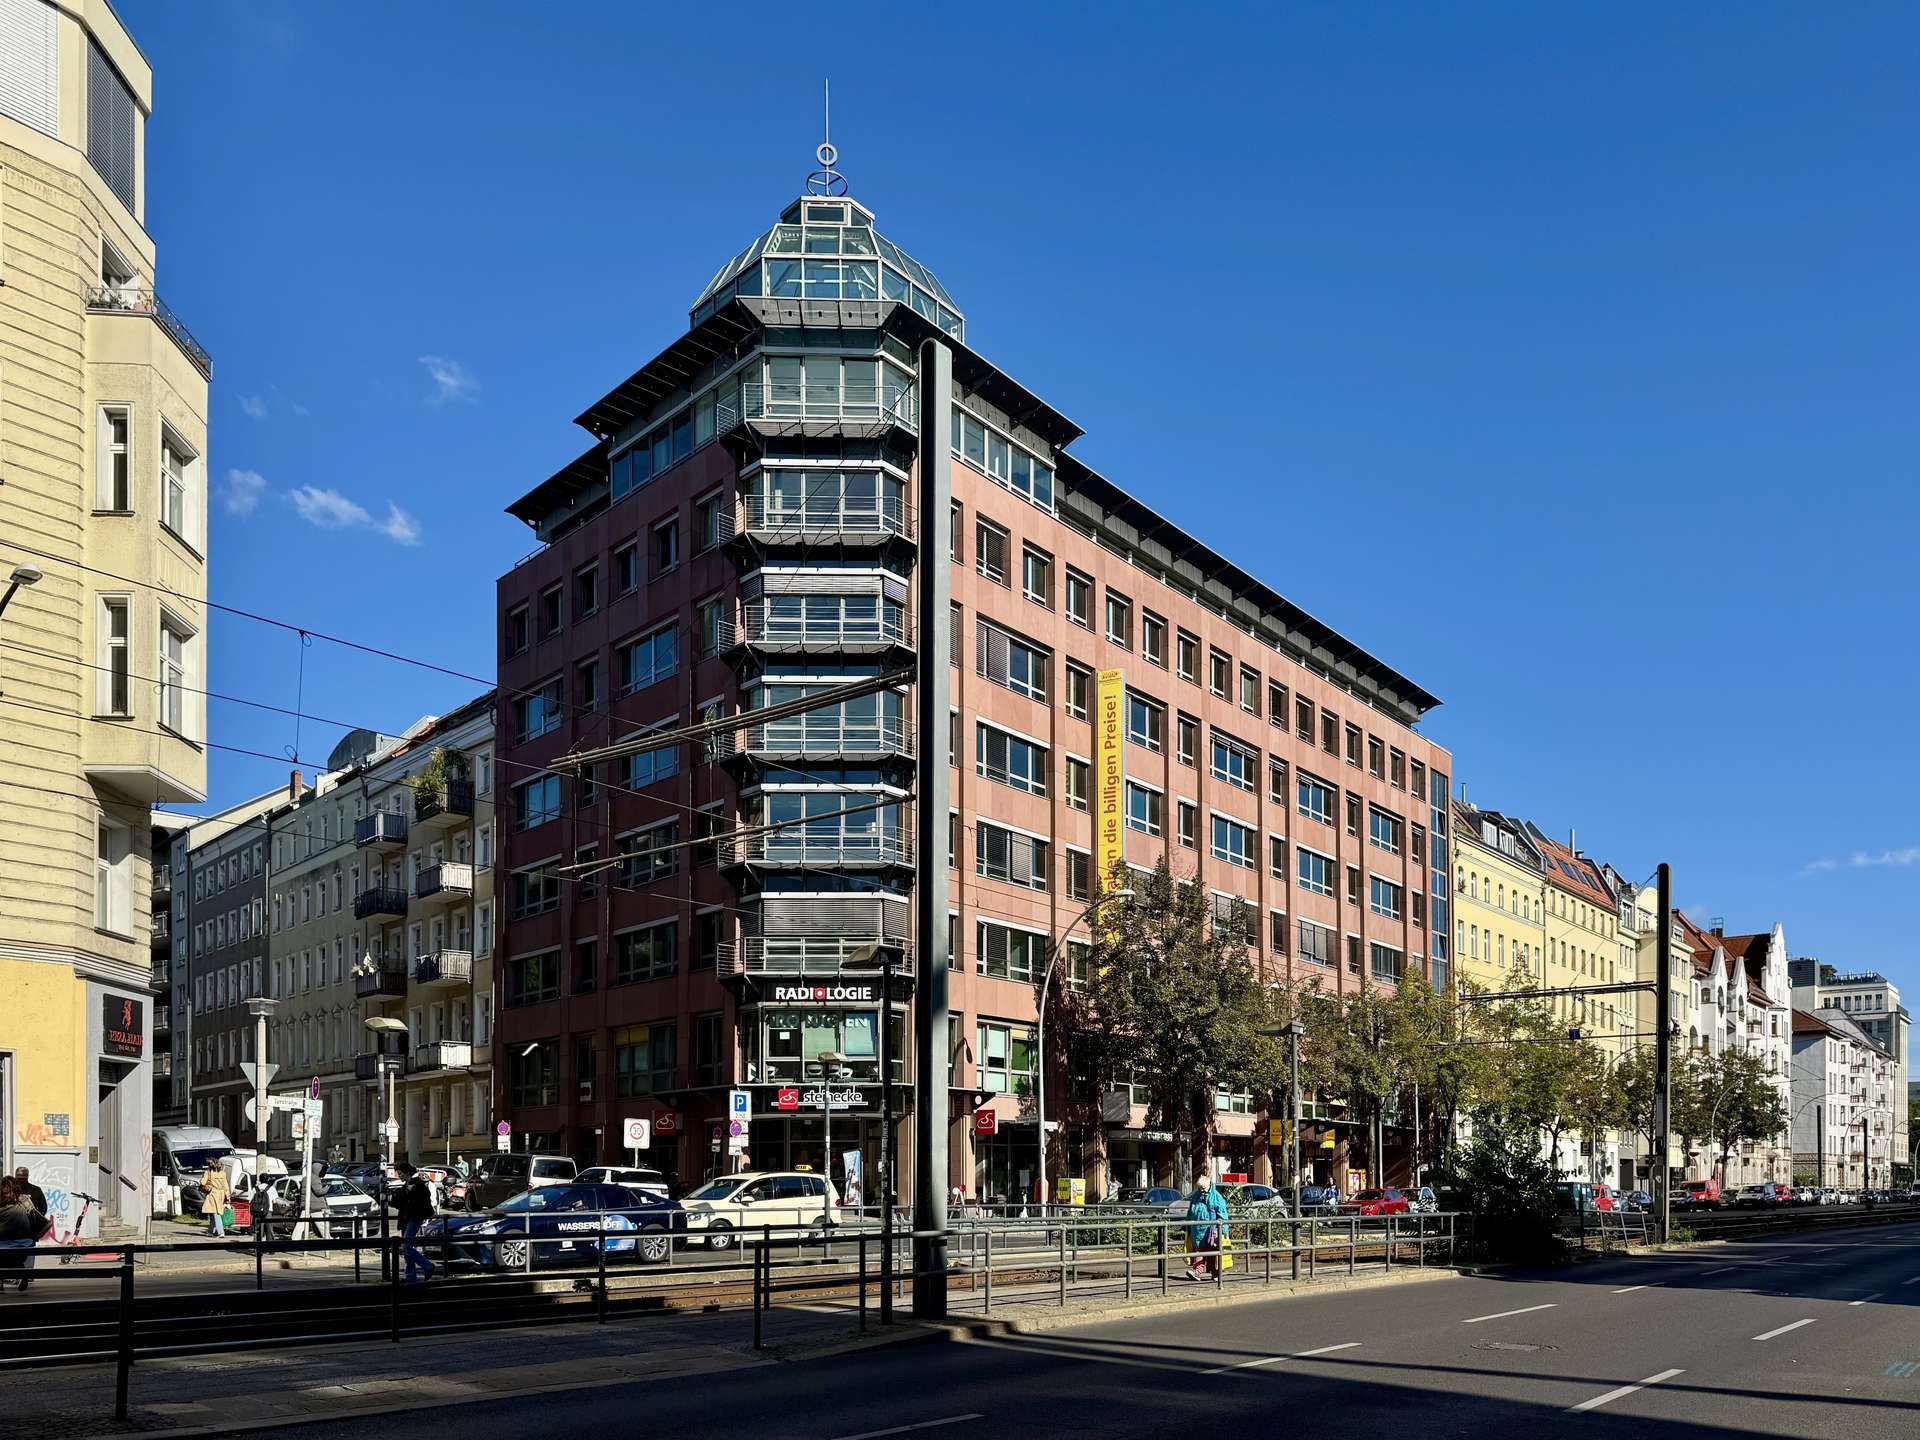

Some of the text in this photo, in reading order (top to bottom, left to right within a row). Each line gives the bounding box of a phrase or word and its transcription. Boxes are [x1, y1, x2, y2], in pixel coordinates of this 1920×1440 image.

[1104, 695, 1116, 749] Preise!
[1104, 754, 1120, 814] billigen
[1104, 818, 1116, 843] die
[775, 986, 872, 1000] RADIOLOGIE
[737, 1097, 744, 1110] P
[633, 1127, 641, 1135] 30
[558, 1220, 623, 1231] WASSERSOFF
